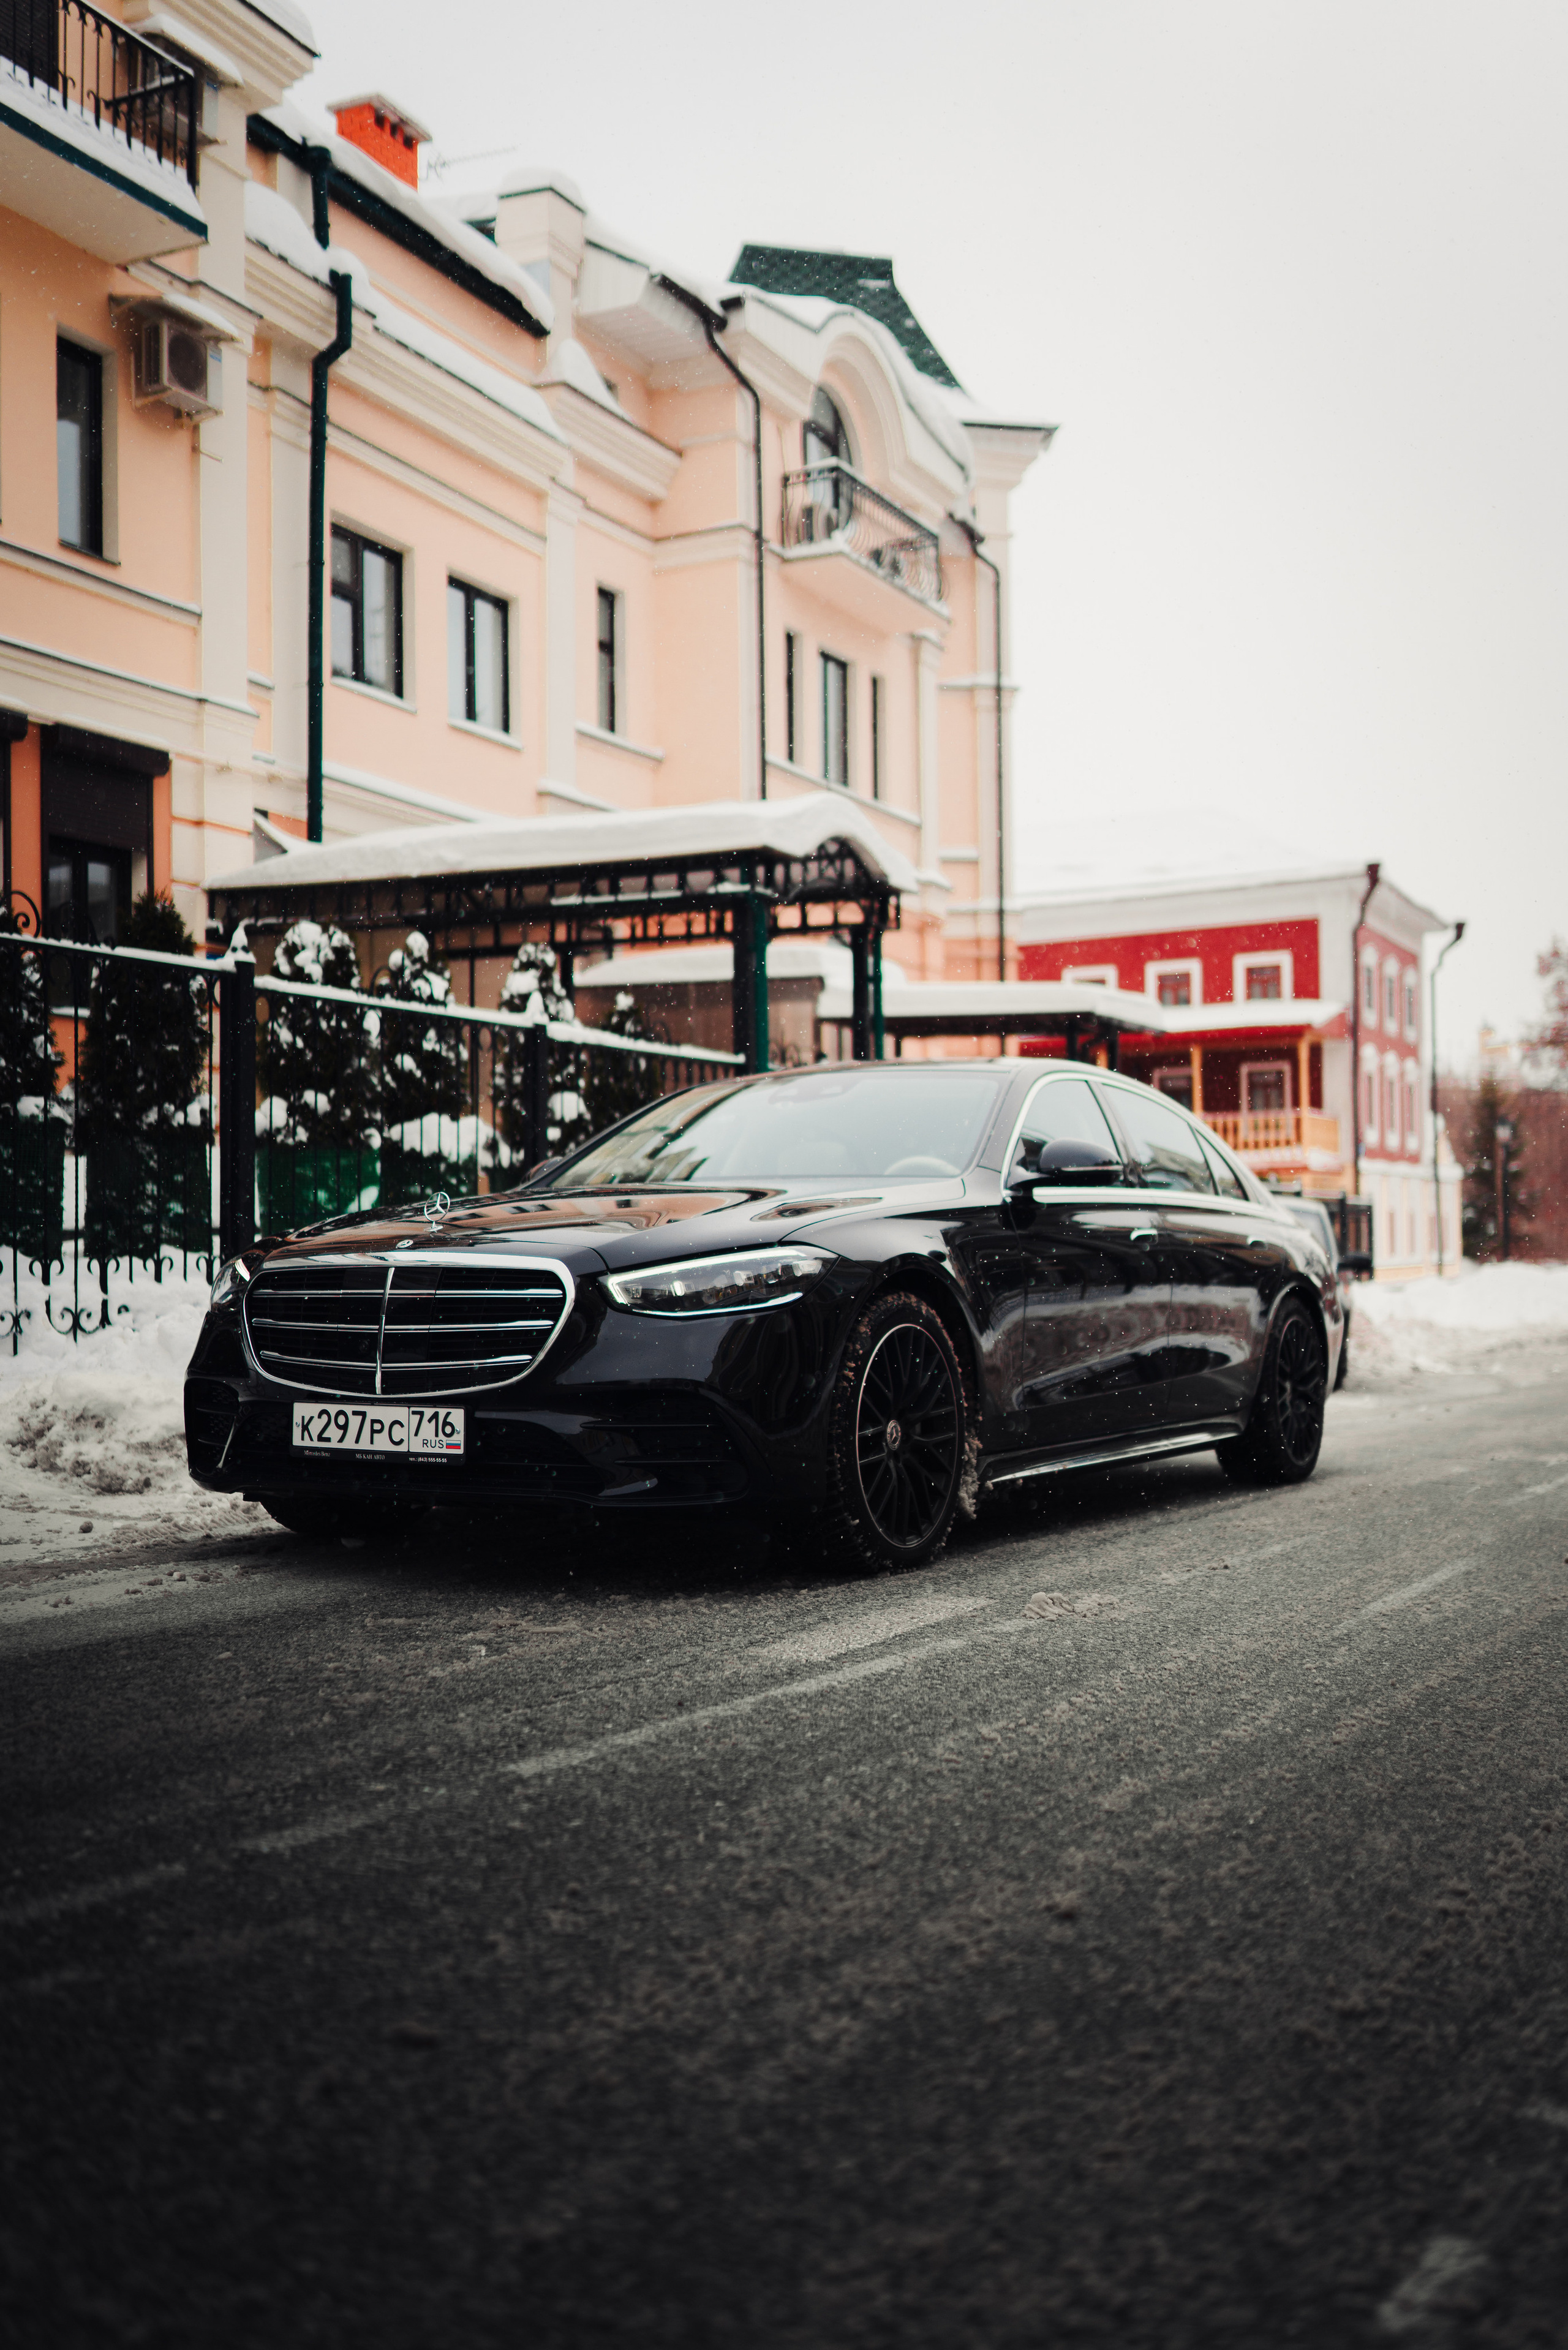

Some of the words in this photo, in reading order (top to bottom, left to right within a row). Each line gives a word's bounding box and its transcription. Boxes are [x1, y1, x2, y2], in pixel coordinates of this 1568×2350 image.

[301, 1409, 405, 1446] К297РС
[411, 1410, 456, 1438] 716
[422, 1439, 444, 1449] RUS
